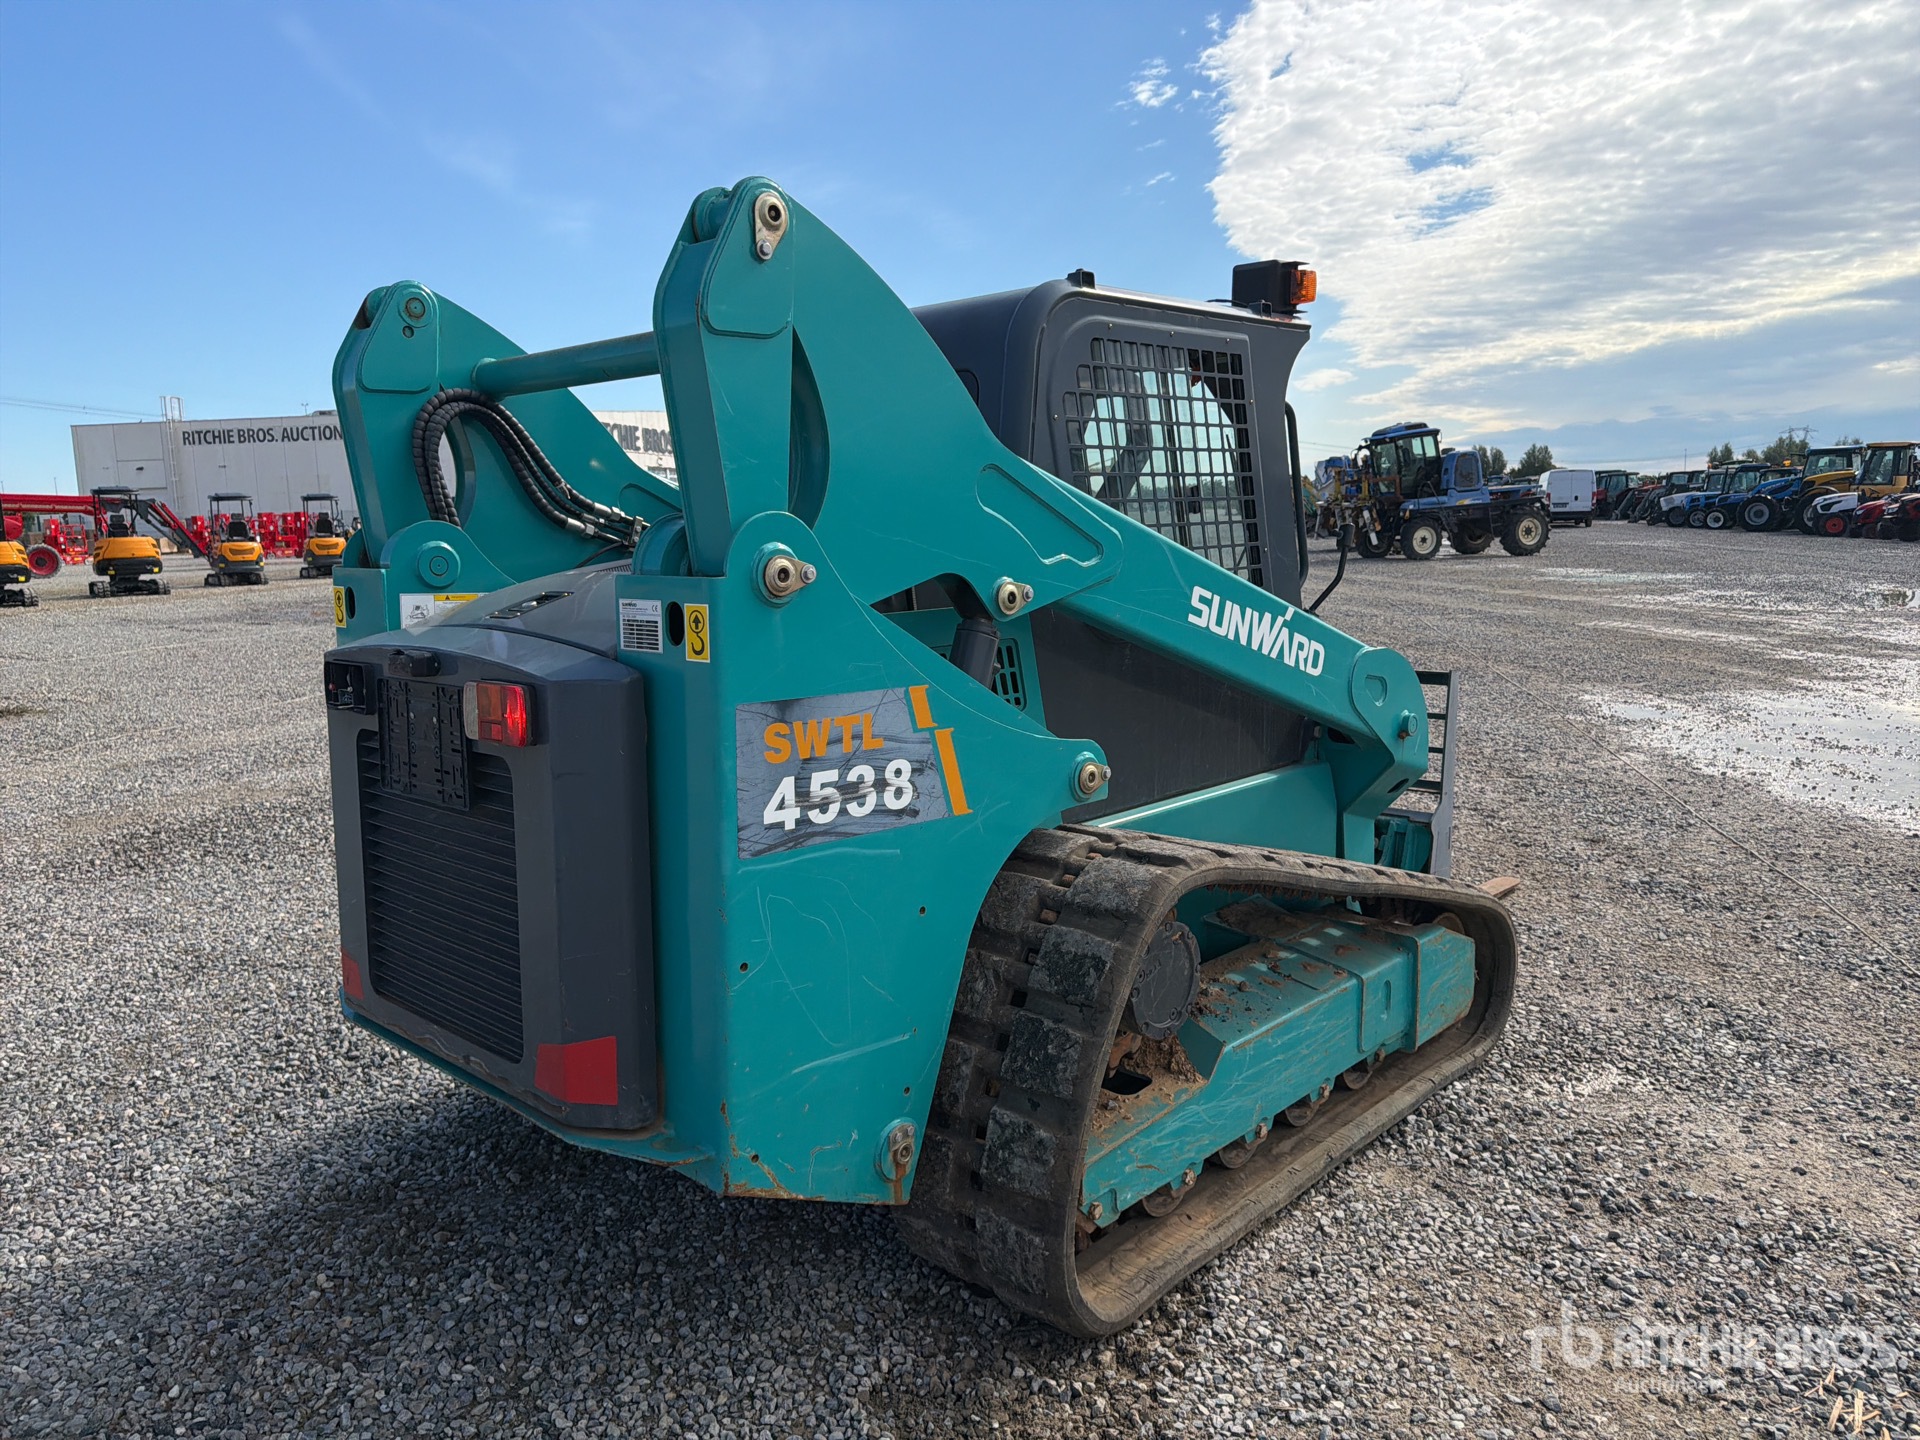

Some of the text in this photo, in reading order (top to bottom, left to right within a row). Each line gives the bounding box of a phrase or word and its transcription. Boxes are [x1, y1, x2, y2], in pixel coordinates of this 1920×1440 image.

[182, 429, 236, 446] RITCHIE
[237, 427, 279, 444] BROS.
[1187, 585, 1325, 676] SUNWARD
[763, 712, 885, 764] SWTL
[763, 758, 914, 831] 4538
